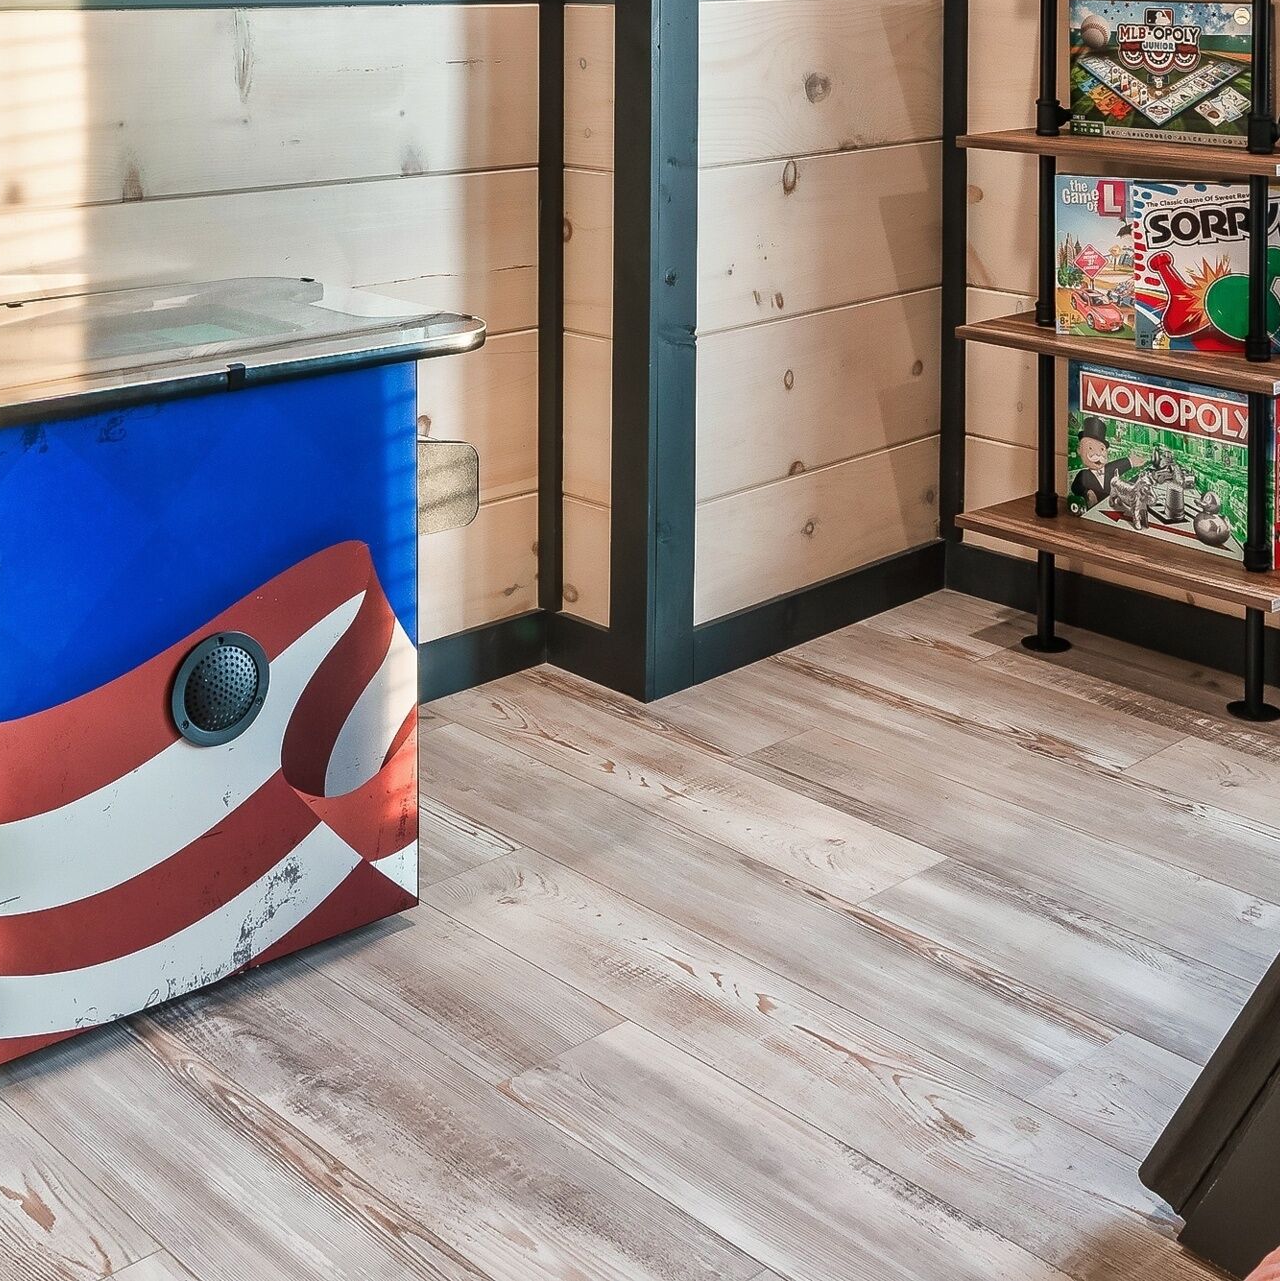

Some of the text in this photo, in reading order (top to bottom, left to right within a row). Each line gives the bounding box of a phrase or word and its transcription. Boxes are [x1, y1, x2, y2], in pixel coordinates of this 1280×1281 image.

[1142, 41, 1174, 51] JUNIOR
[1070, 180, 1088, 193] the
[1062, 188, 1100, 205] Game
[1160, 199, 1183, 207] Classic
[1183, 196, 1204, 205] Game
[1214, 192, 1236, 201] Sweet
[1236, 191, 1250, 199] Rev
